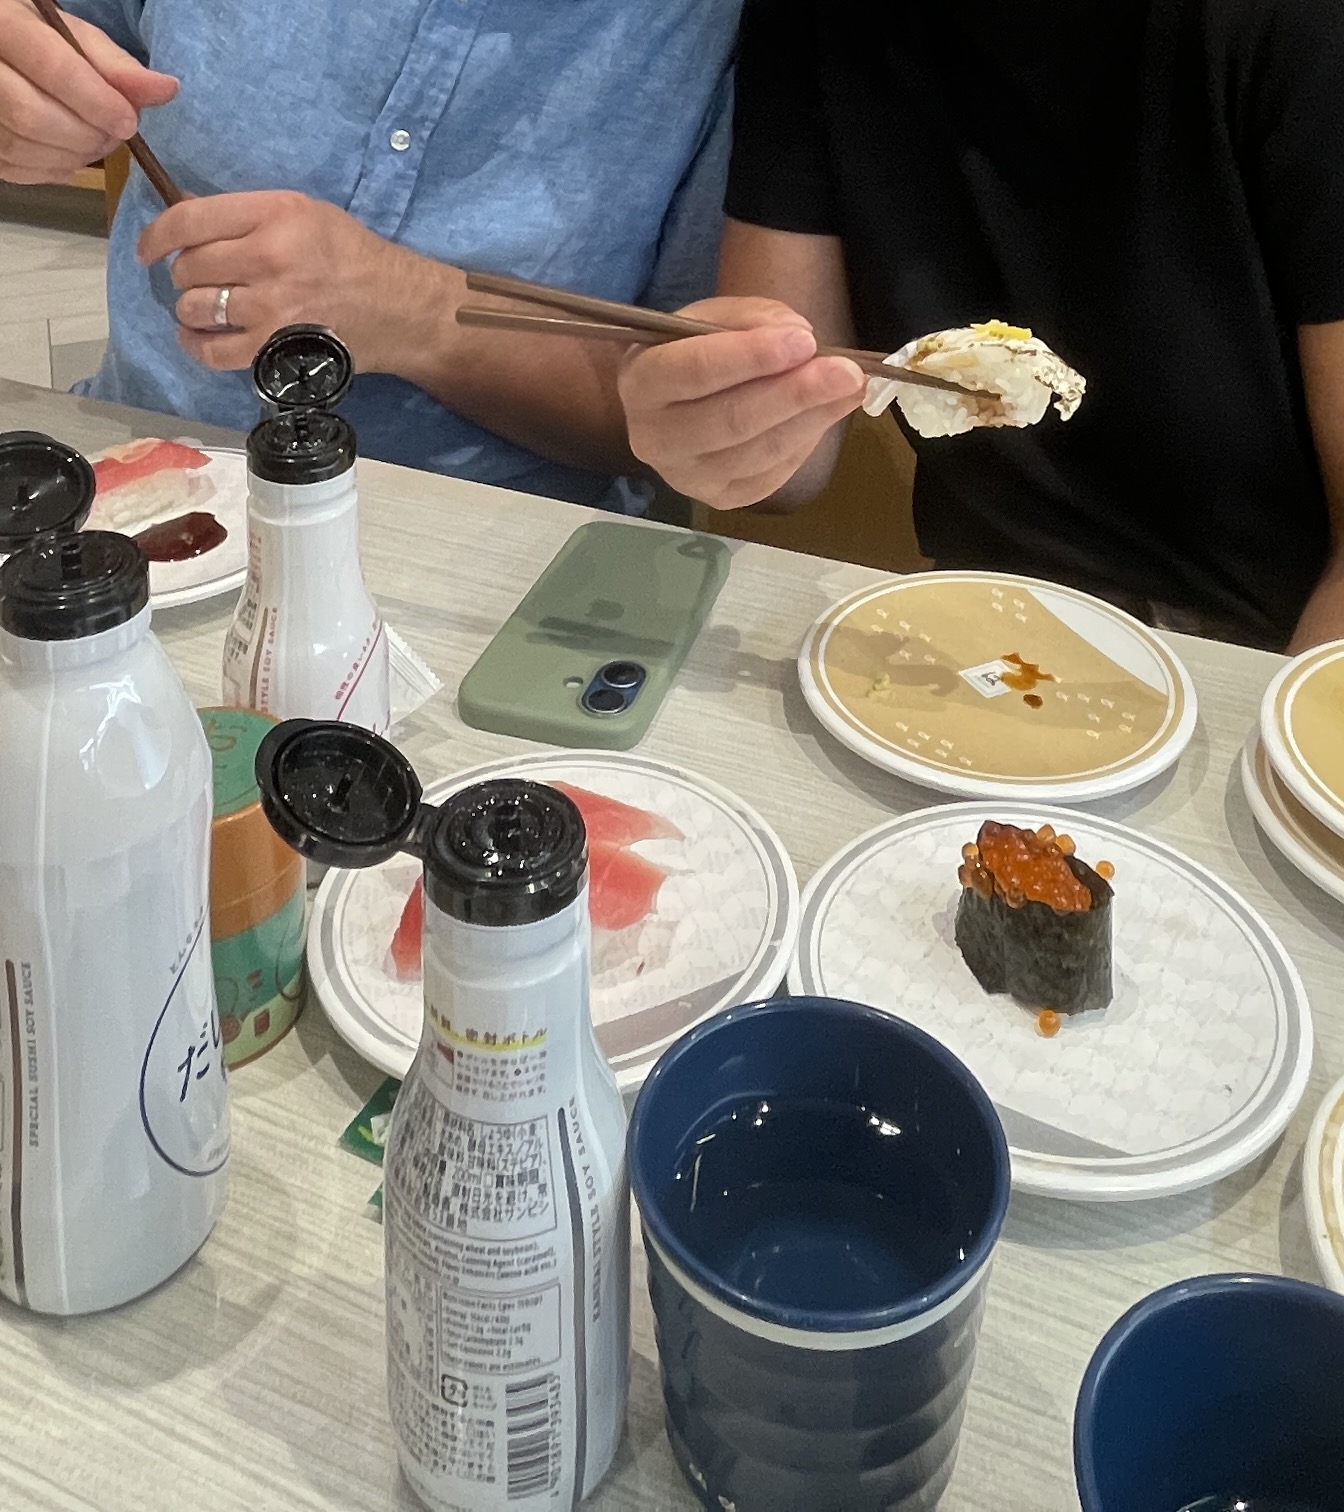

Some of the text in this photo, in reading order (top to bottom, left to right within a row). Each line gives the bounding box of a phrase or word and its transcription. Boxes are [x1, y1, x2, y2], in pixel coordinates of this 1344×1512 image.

[21, 961, 34, 1006] SAUCE
[25, 1009, 36, 1036] SOY
[567, 1095, 587, 1157] SAUCE
[582, 1164, 598, 1201] SOY
